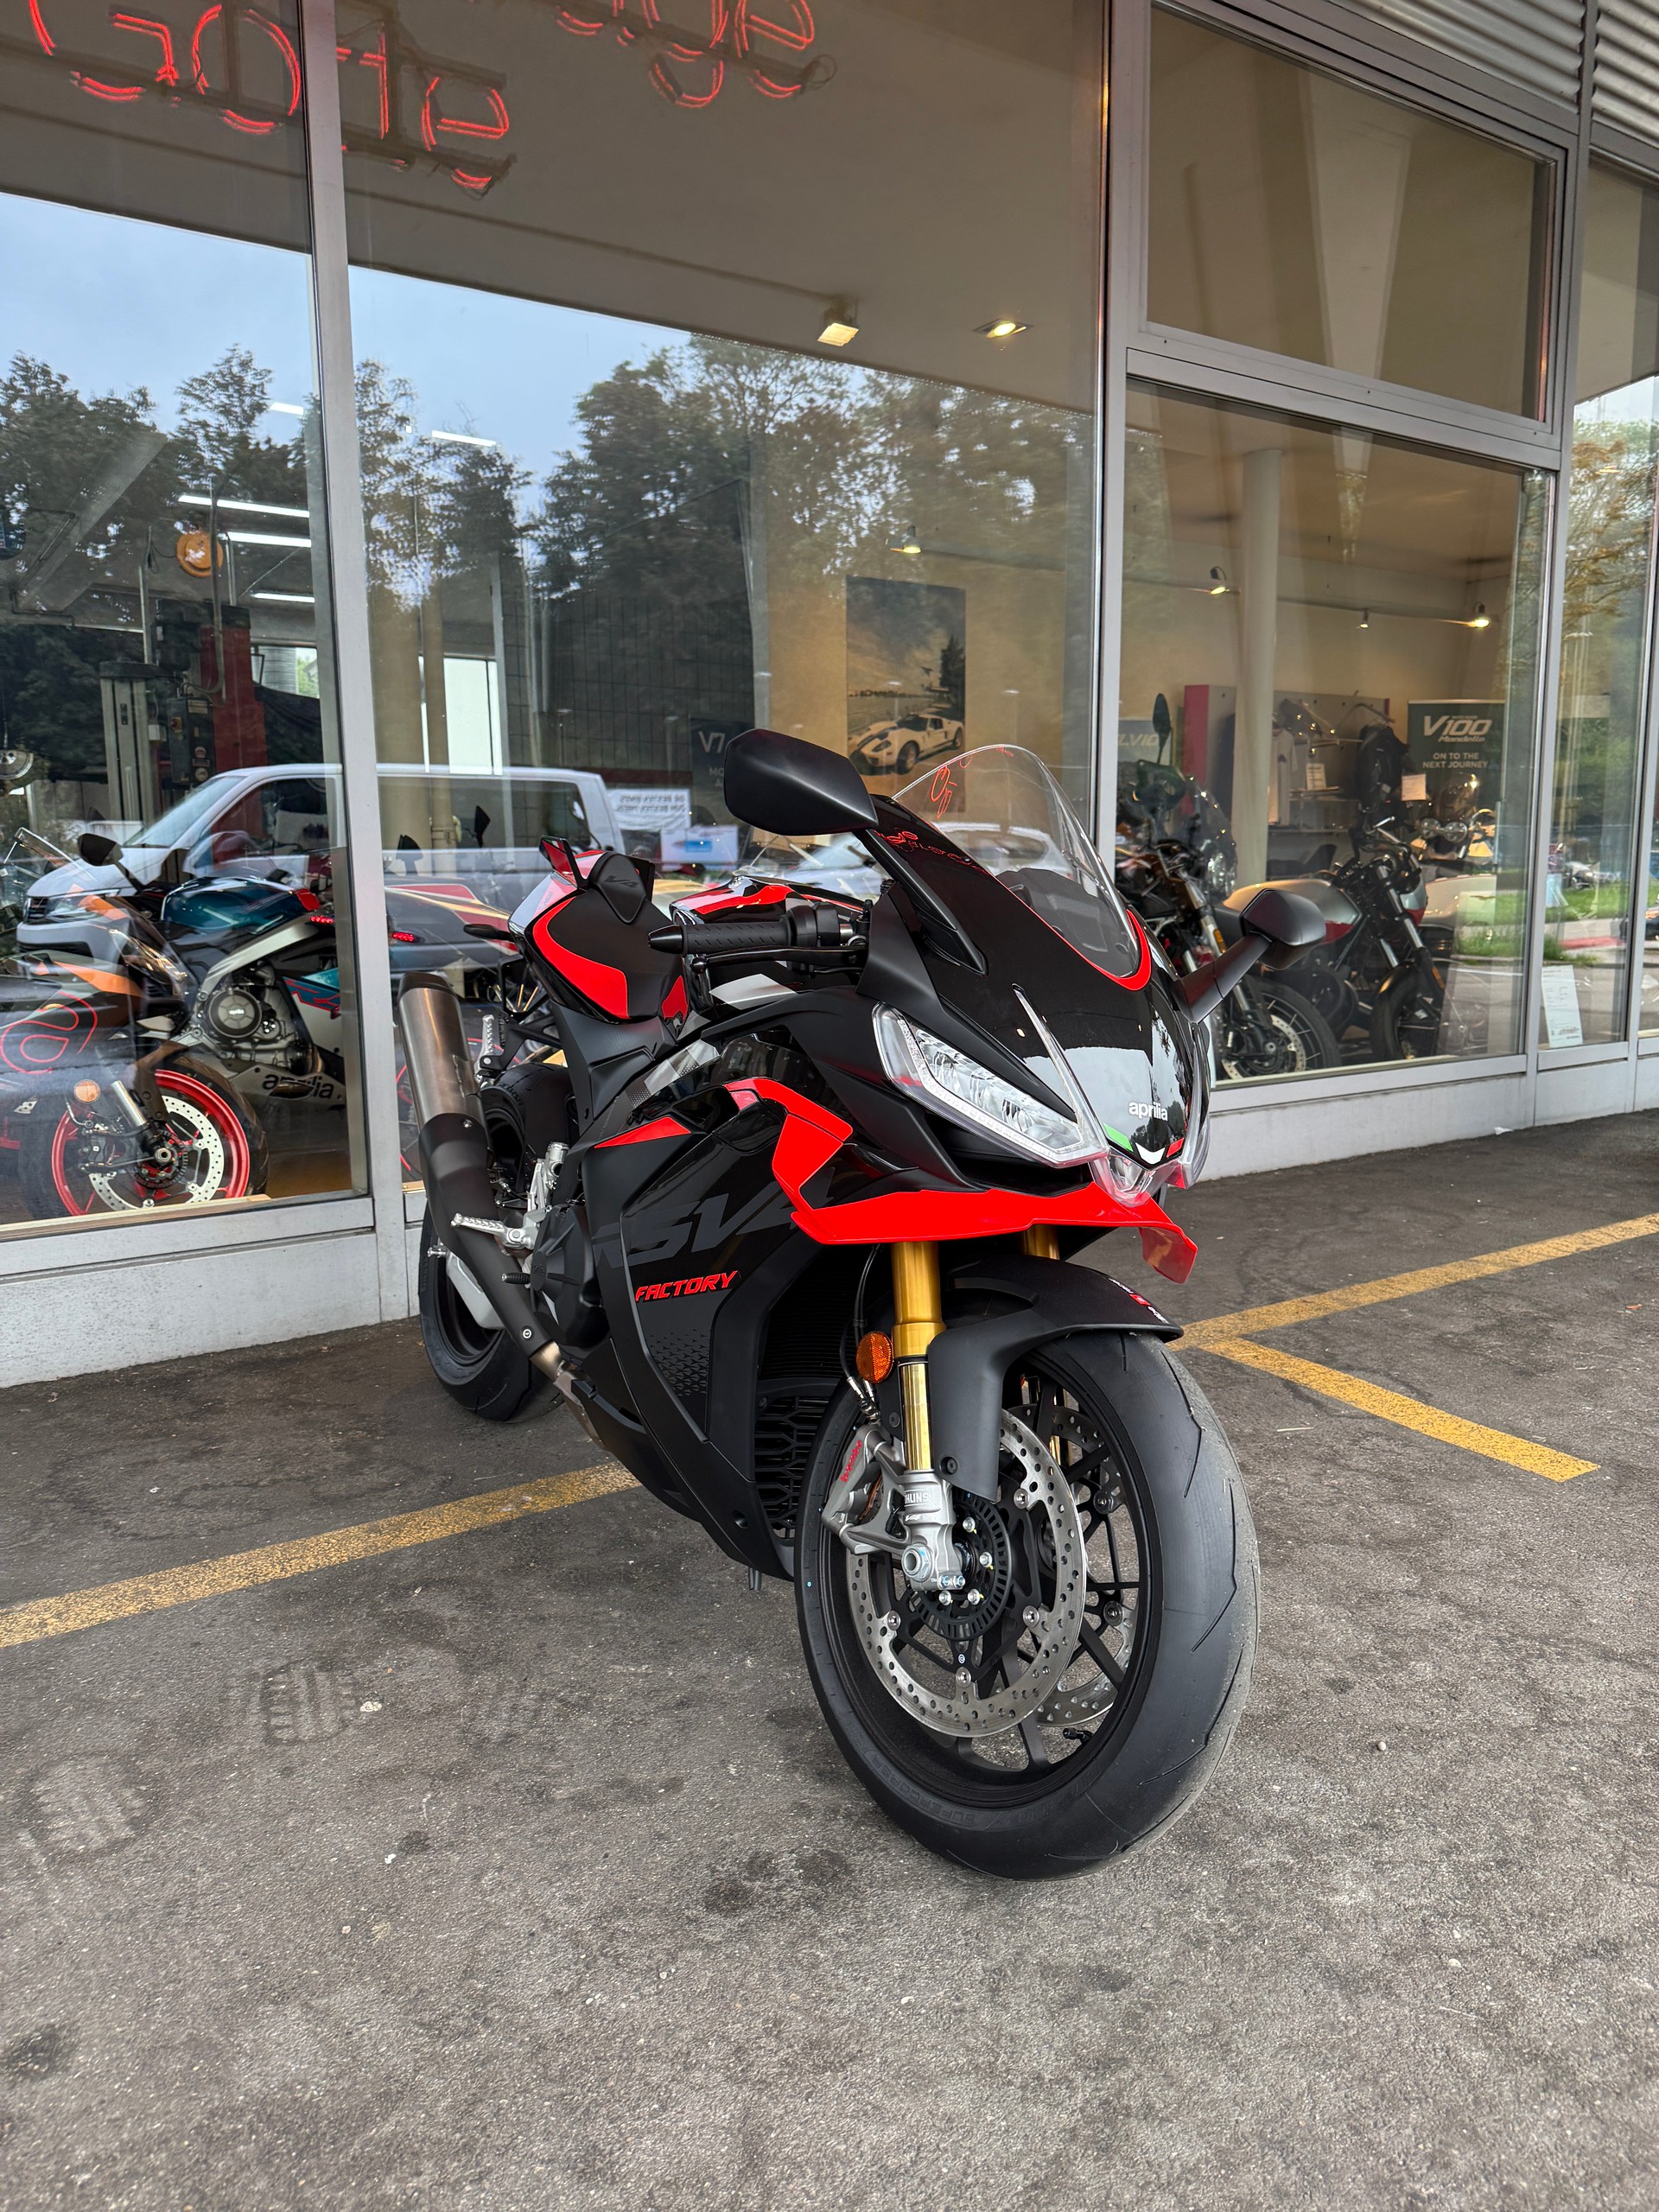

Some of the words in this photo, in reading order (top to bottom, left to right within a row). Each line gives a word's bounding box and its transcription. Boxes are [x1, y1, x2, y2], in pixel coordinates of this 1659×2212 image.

[1423, 715, 1493, 736] V100
[698, 731, 726, 754] V7
[1118, 733, 1160, 747] LVIO
[1433, 752, 1447, 760] ON
[1448, 752, 1460, 760] TO
[1463, 752, 1479, 760] THE
[1447, 760, 1488, 769] JOURNEY
[262, 1073, 334, 1100] alia
[1128, 1101, 1168, 1122] aprilia
[634, 1270, 738, 1303] FACTORY
[904, 1491, 930, 1505] HLINS
